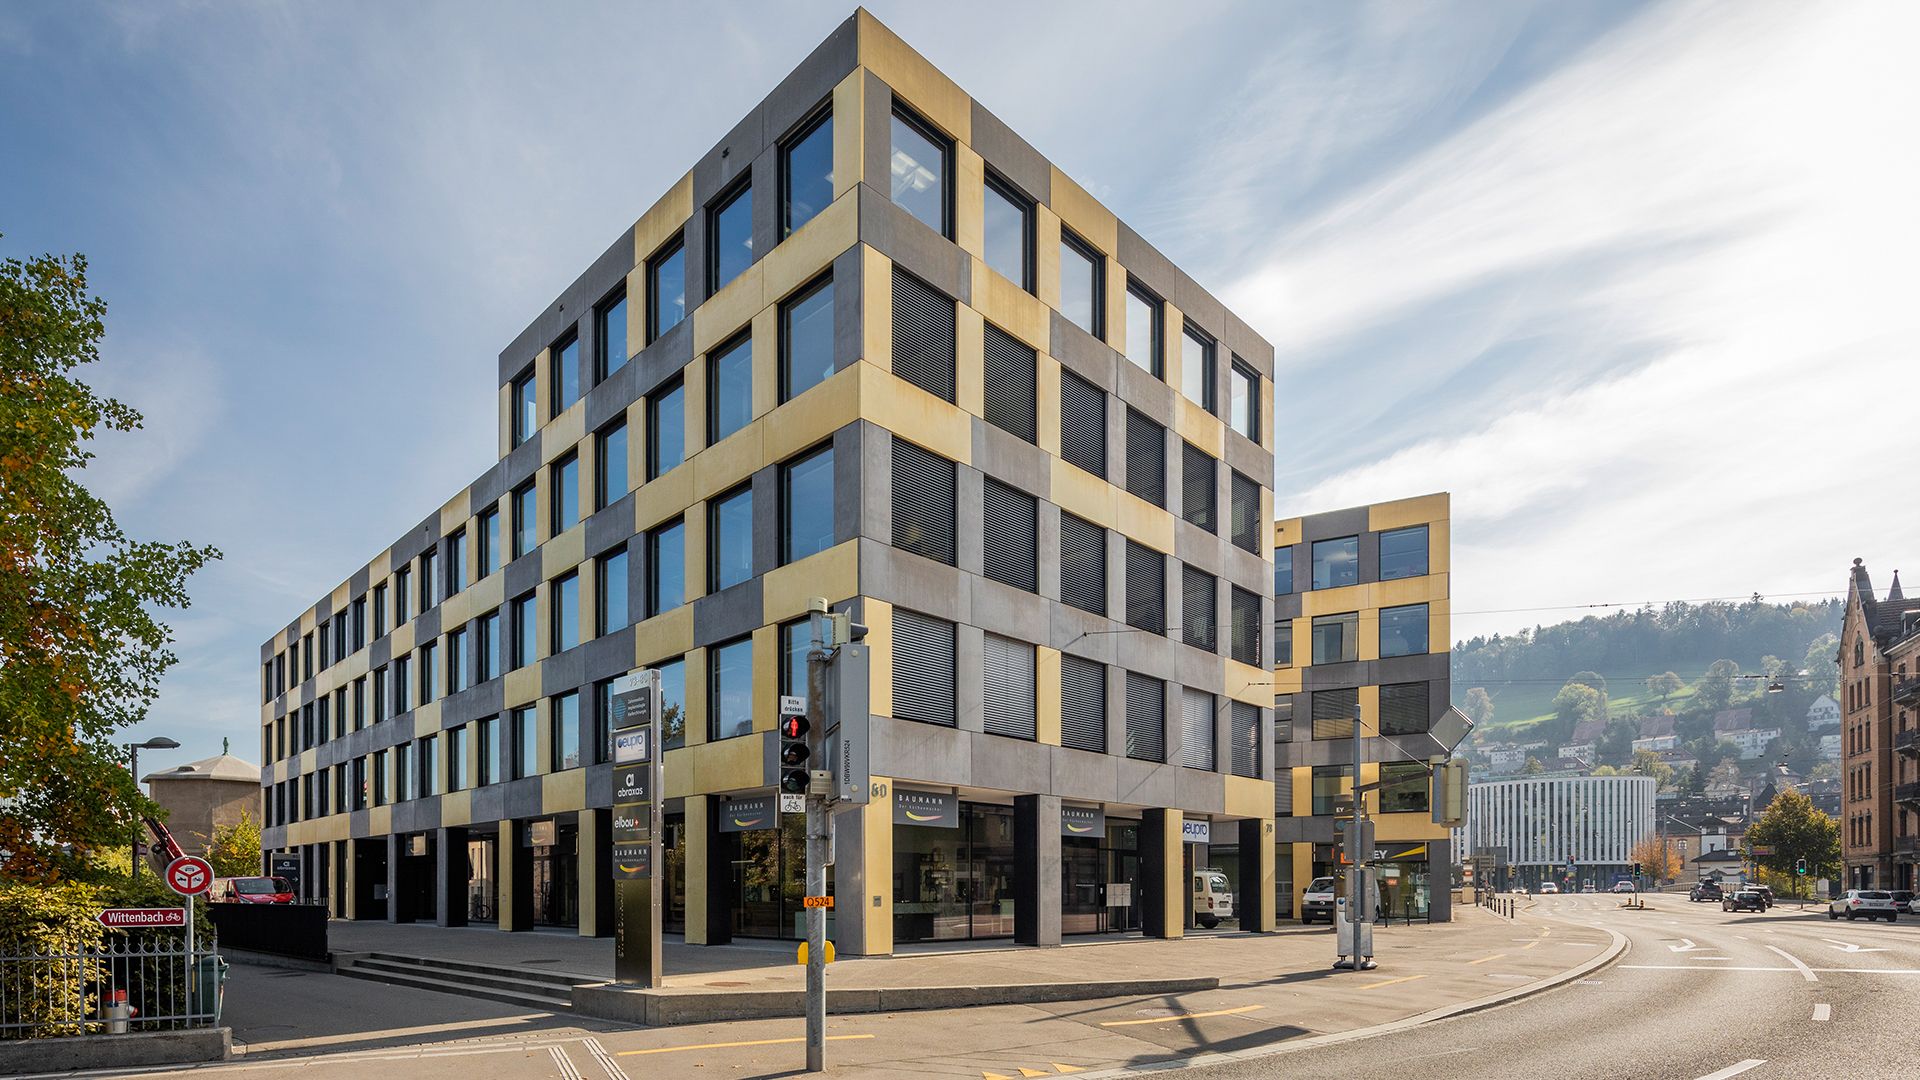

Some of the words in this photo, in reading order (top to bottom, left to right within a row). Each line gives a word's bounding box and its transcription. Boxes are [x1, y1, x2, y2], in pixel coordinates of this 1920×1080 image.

[618, 788, 643, 797] abraxas
[899, 795, 943, 805] BAUMANN
[730, 802, 764, 811] BAUMANN
[1062, 810, 1094, 818] BAUMANN
[1374, 850, 1388, 859] EY
[806, 897, 829, 907] Q524
[107, 911, 164, 923] Wittenbach
